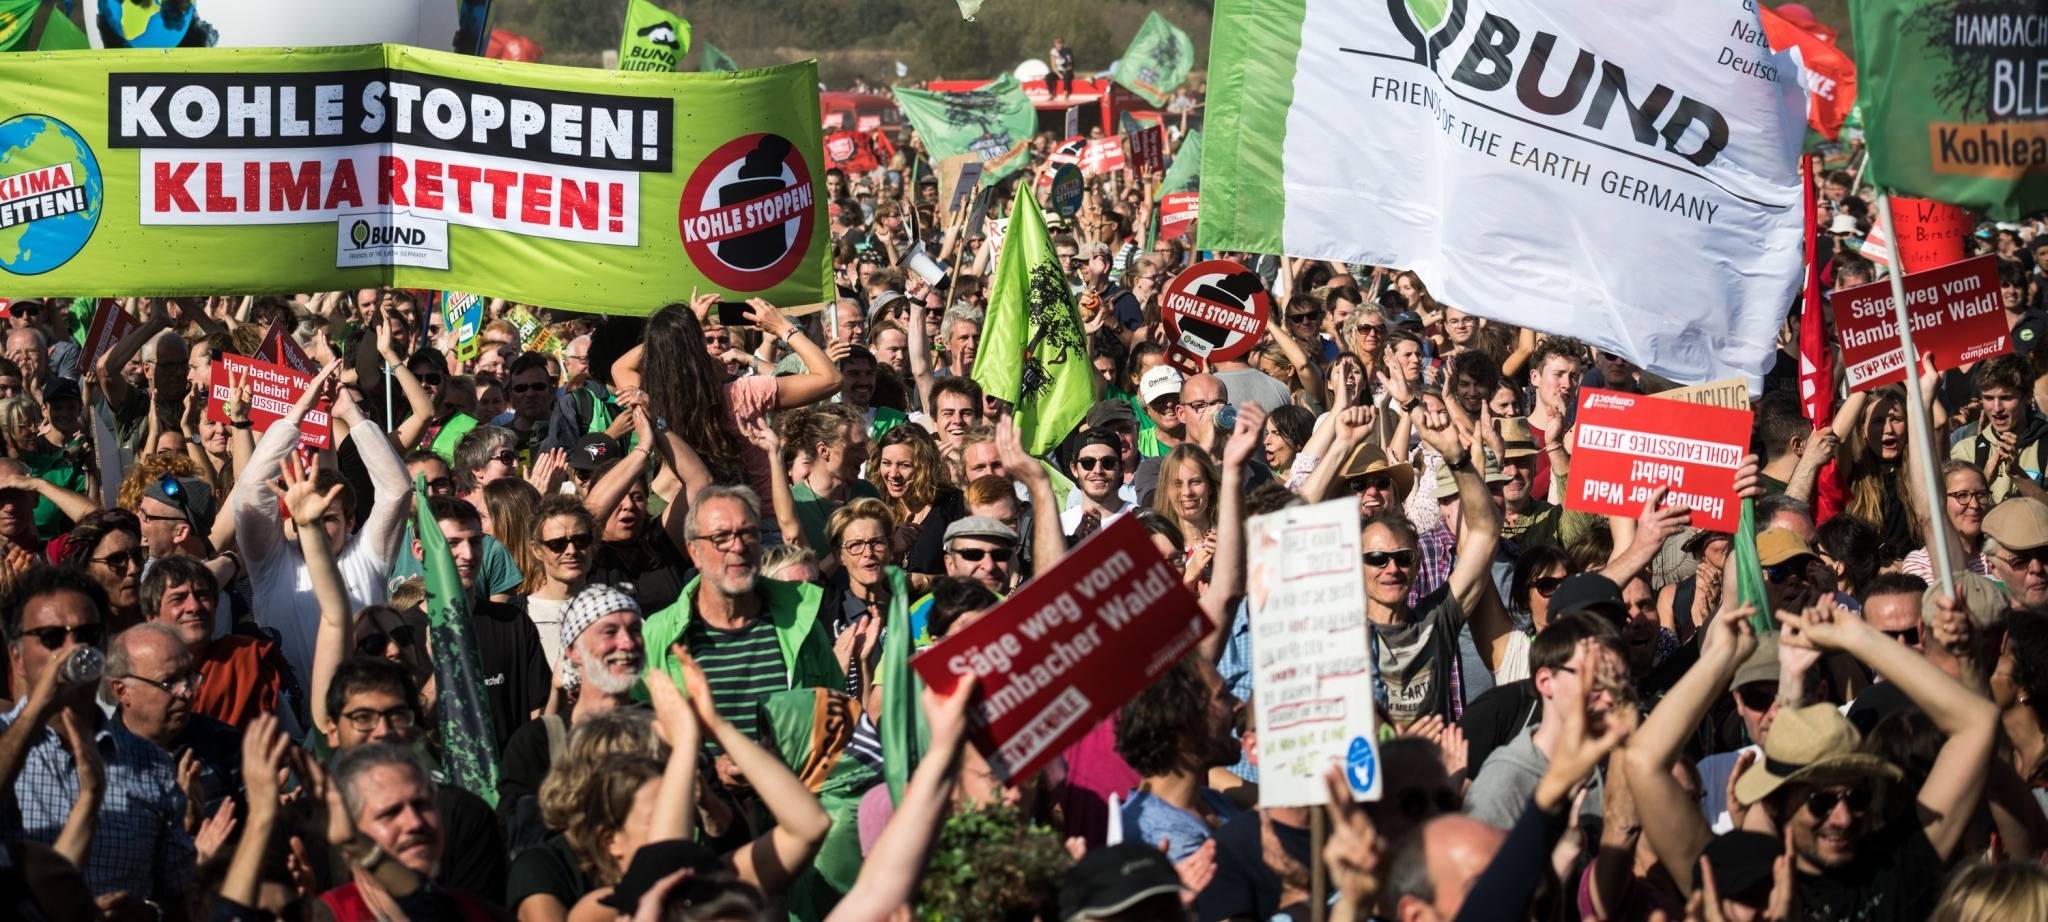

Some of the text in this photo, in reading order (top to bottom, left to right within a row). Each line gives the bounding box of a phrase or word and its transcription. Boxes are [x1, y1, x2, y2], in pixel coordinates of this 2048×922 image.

[630, 45, 676, 66] BUND
[1452, 10, 1730, 167] BUND
[120, 80, 659, 162] KOHLE STOPPEN!
[1442, 108, 1456, 135] OF
[1460, 120, 1503, 158] THE
[1508, 140, 1591, 186] EARTH
[1599, 169, 1720, 225] GERMANY
[0, 188, 84, 228] ETTEN!
[154, 155, 624, 233] KLIMA RETTEN!
[683, 182, 813, 243] KOHLE STOPPEN!
[371, 226, 426, 246] BUND
[1166, 293, 1261, 335] KOHLE STOPPEN!
[1851, 274, 1981, 319] Säge weg vom
[1842, 291, 2000, 350] Hambacher Wald!
[1189, 340, 1207, 351] BUND
[253, 379, 290, 400] bleibt!
[1582, 427, 1739, 466] KOHLEAUSSTIEG JETZT!
[1583, 479, 1624, 505] Wald
[1631, 460, 1684, 488] bleibt!
[948, 549, 1135, 679] Säge weg vom
[1096, 560, 1177, 632] Wald!
[1395, 703, 1417, 712] MILES
